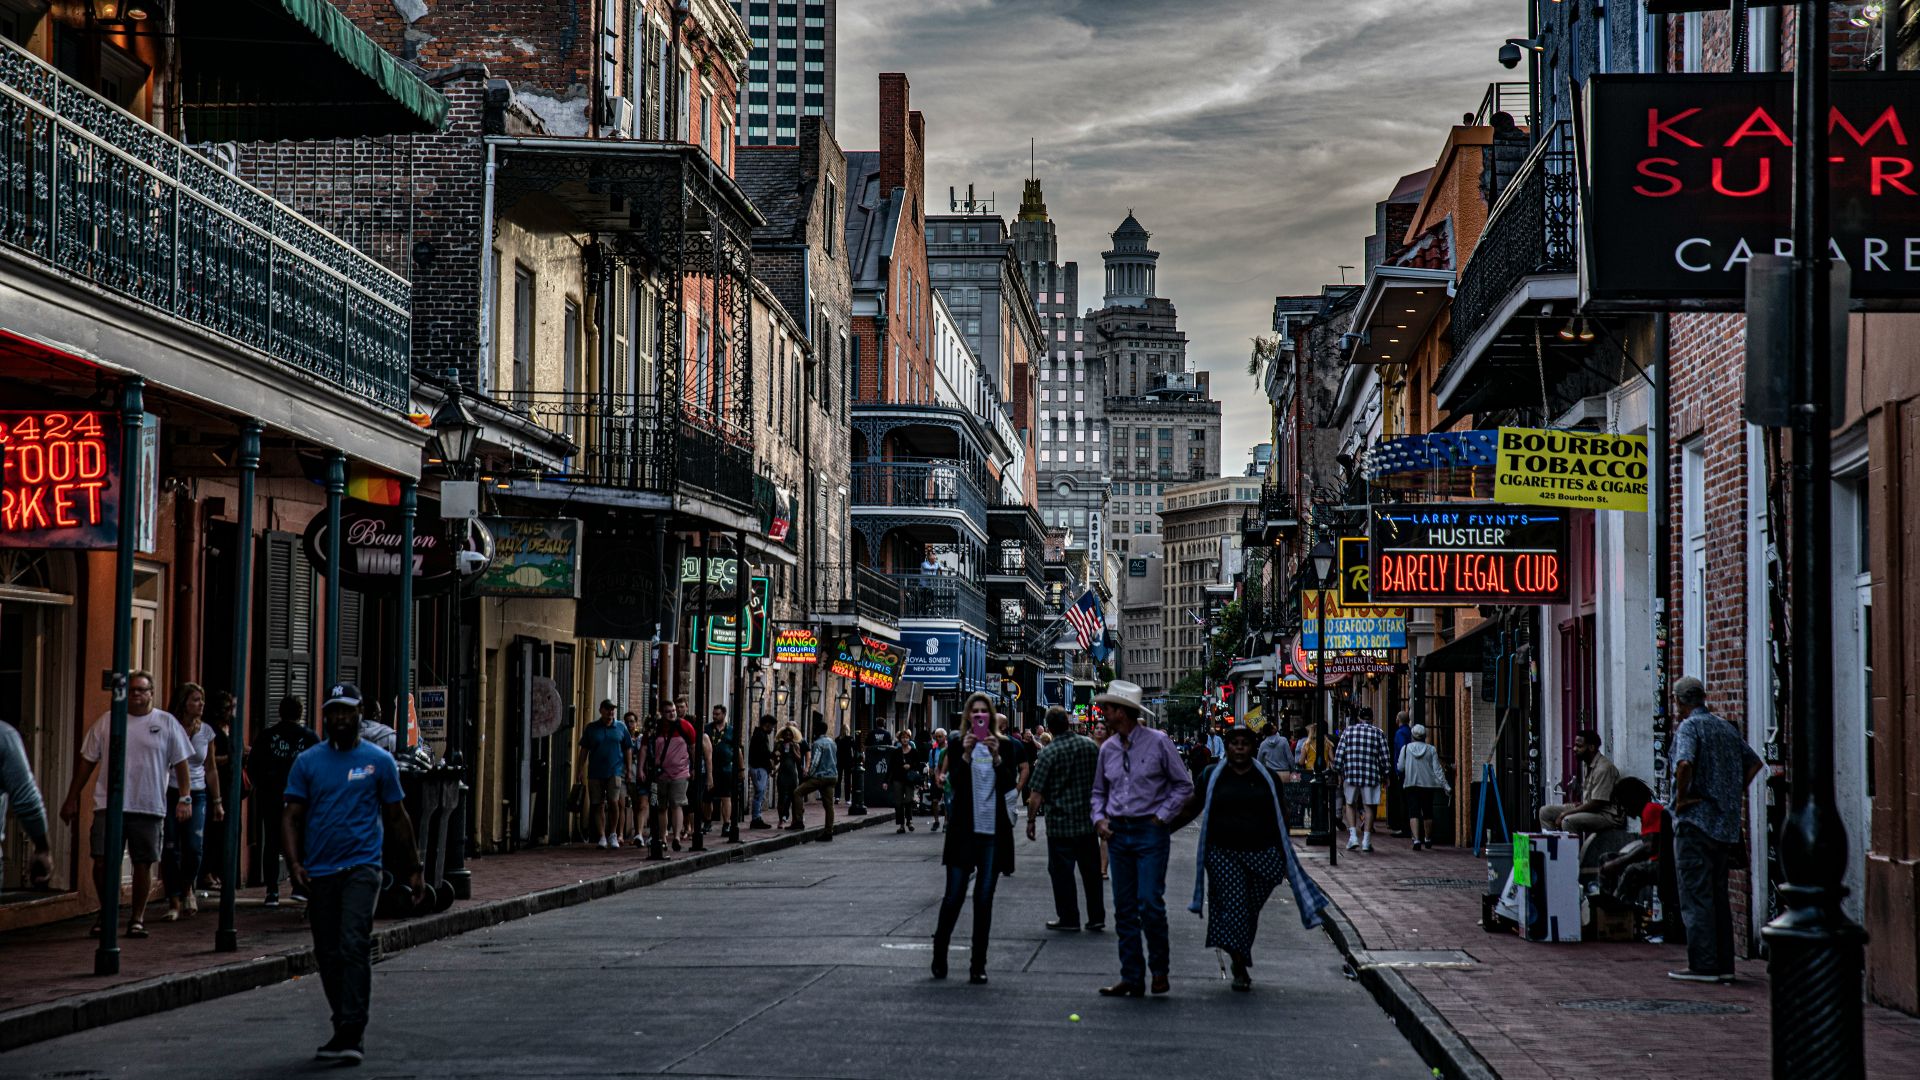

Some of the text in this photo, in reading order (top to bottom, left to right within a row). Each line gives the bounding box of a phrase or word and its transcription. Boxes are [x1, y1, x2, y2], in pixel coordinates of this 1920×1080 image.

[1632, 156, 1919, 198] SUR
[13, 411, 104, 440] 424
[1502, 433, 1648, 458] BOURBON
[1505, 454, 1648, 479] TOBACCO
[1500, 474, 1648, 494] CIGARETTES & CIGARS
[1558, 493, 1594, 502] Bourbon
[1597, 495, 1608, 503] St.
[1413, 514, 1528, 526] LARRY FLYNT'S
[347, 518, 438, 548] Bouron
[1381, 553, 1559, 593] BARELY LEGAL CLUB
[782, 630, 811, 638] MANGO
[1335, 619, 1375, 634] SEAFOOD
[1378, 619, 1405, 633] STEAKS
[776, 636, 818, 647] MANGO
[1324, 634, 1352, 649] YSTERS
[928, 656, 952, 664] SONESTA
[1308, 649, 1337, 660] CHKEN
[1334, 656, 1374, 665] AUTHENTIC
[840, 652, 892, 675] DAQUIRIS
[1333, 664, 1365, 673] ORLEANS
[1367, 664, 1394, 673] CUISINE
[421, 710, 445, 718] MENU
